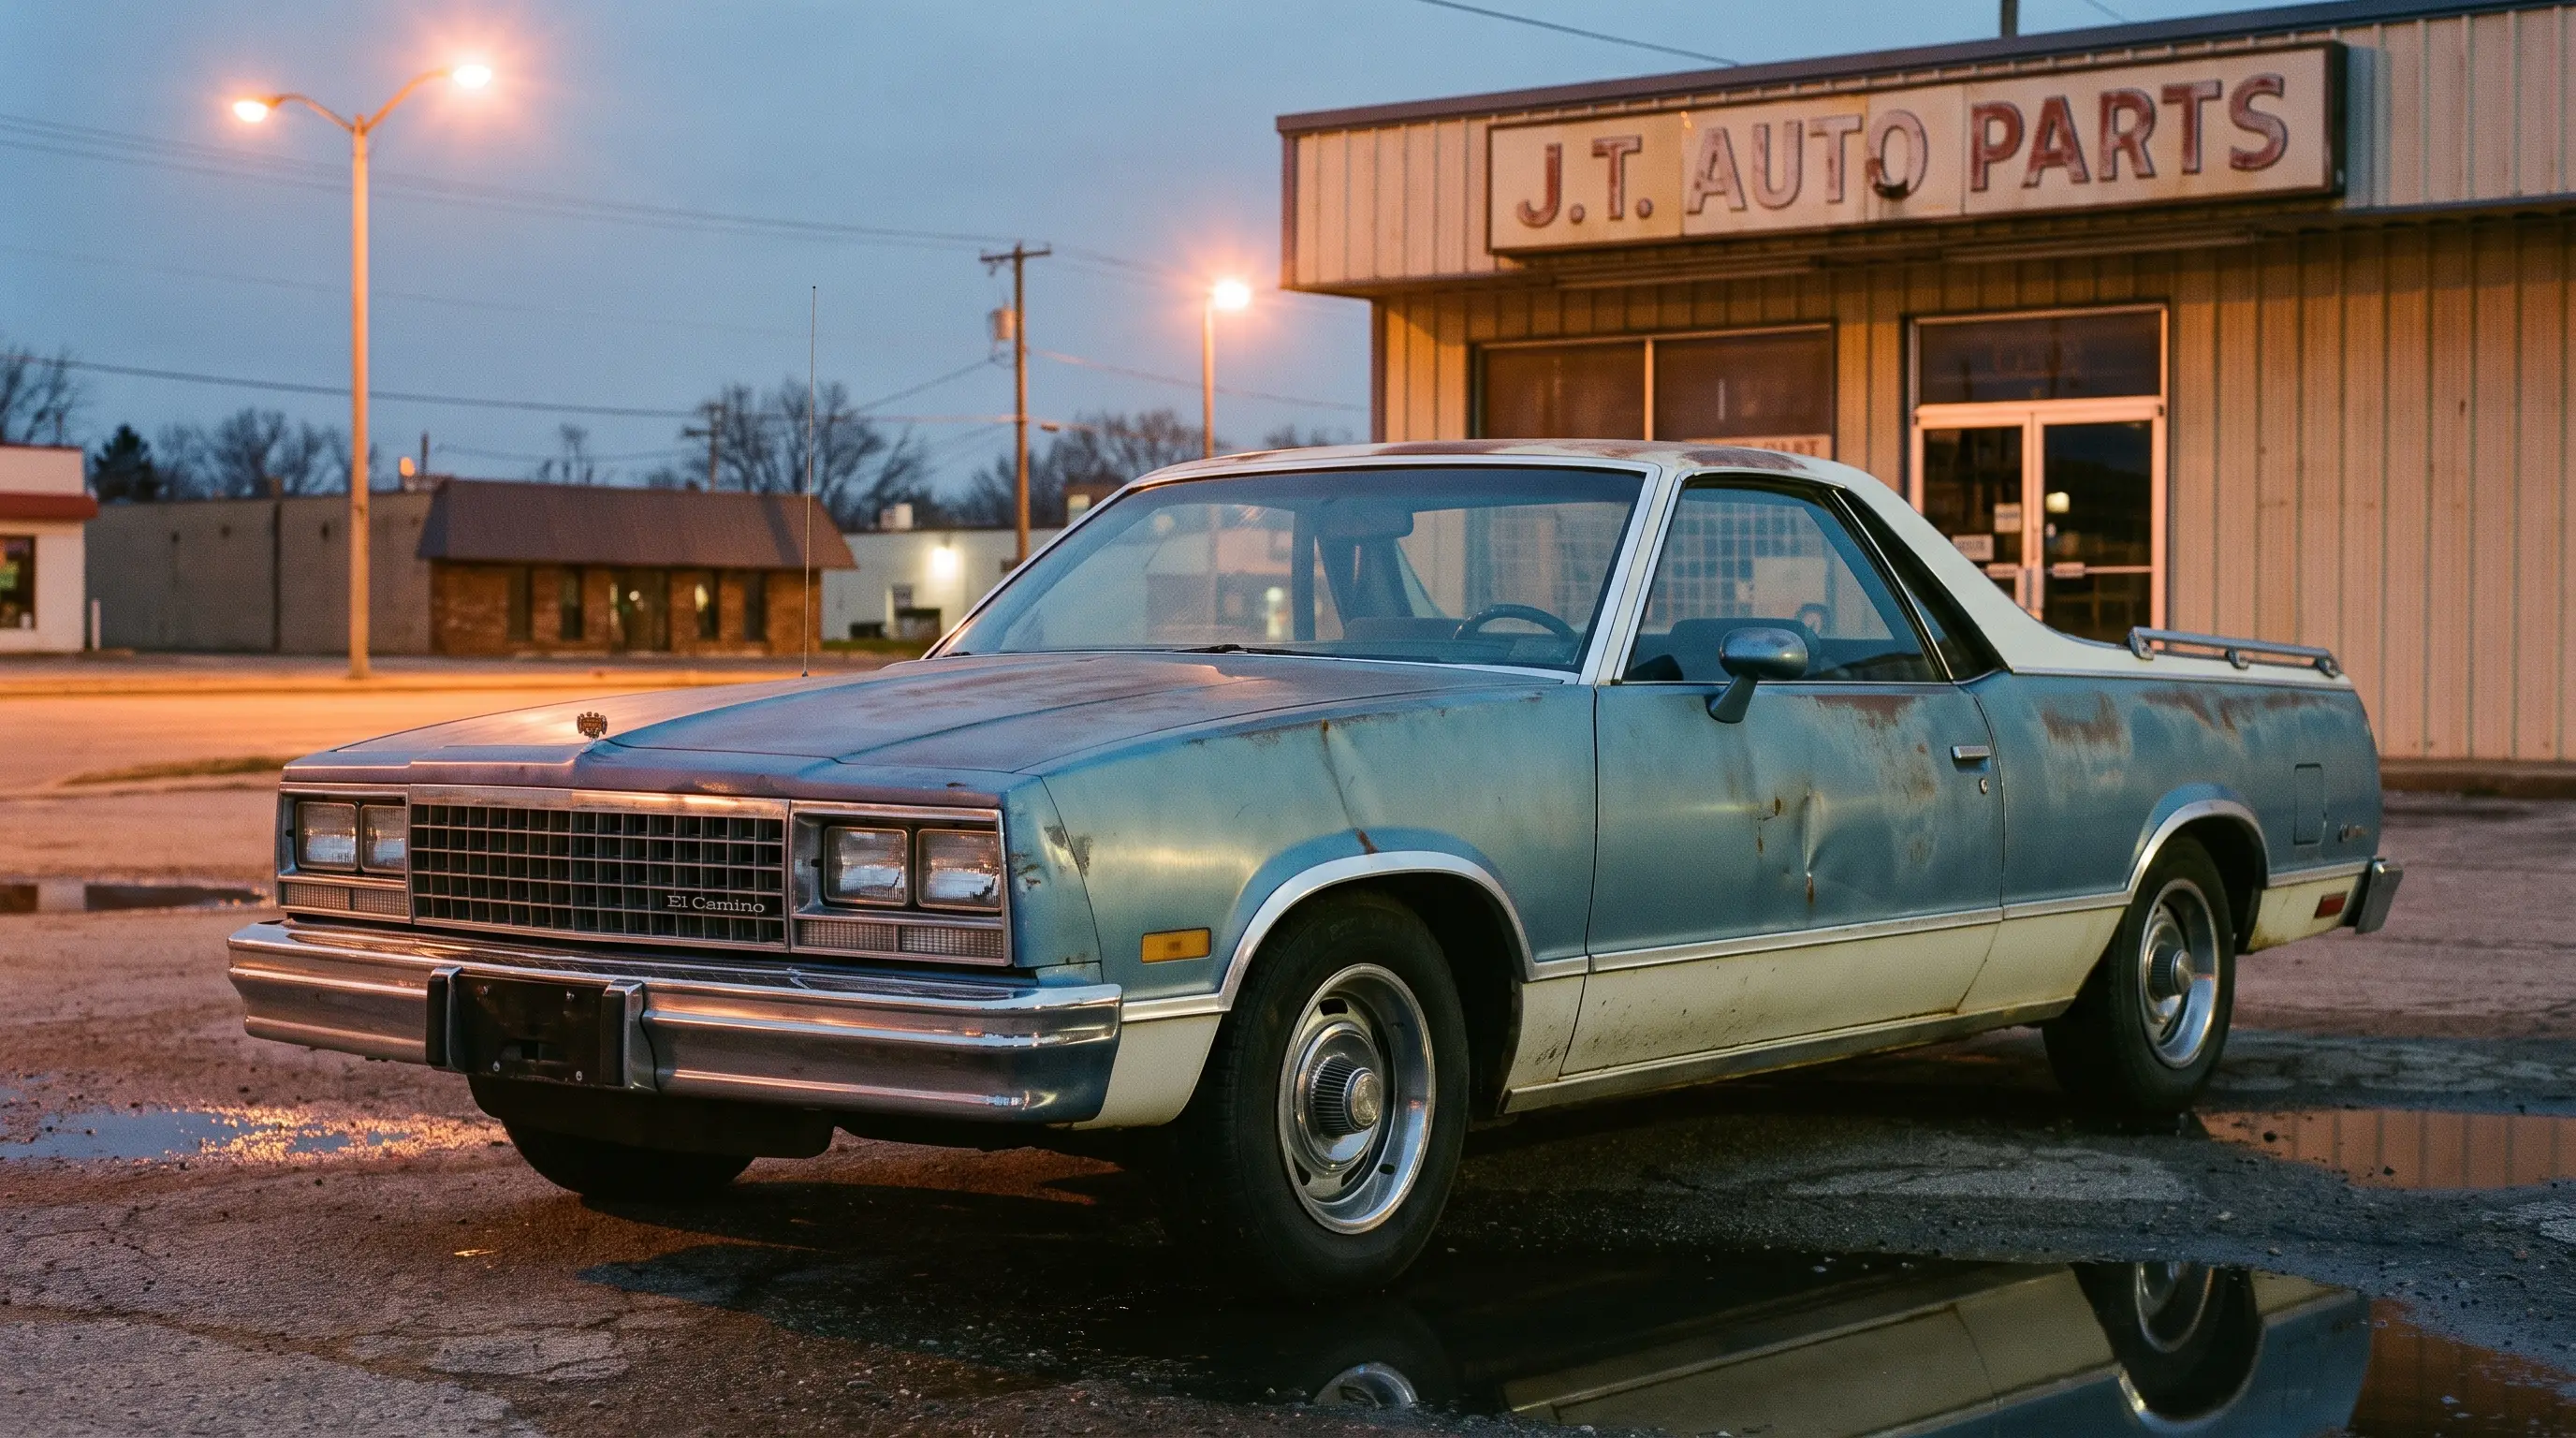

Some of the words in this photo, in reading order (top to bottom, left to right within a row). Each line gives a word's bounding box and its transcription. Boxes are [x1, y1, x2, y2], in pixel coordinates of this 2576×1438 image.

[1516, 134, 1653, 227] J.T.
[1686, 109, 1928, 215] AUTO
[1969, 73, 2288, 192] PARTS
[667, 895, 688, 908] El
[692, 897, 765, 913] Camino
